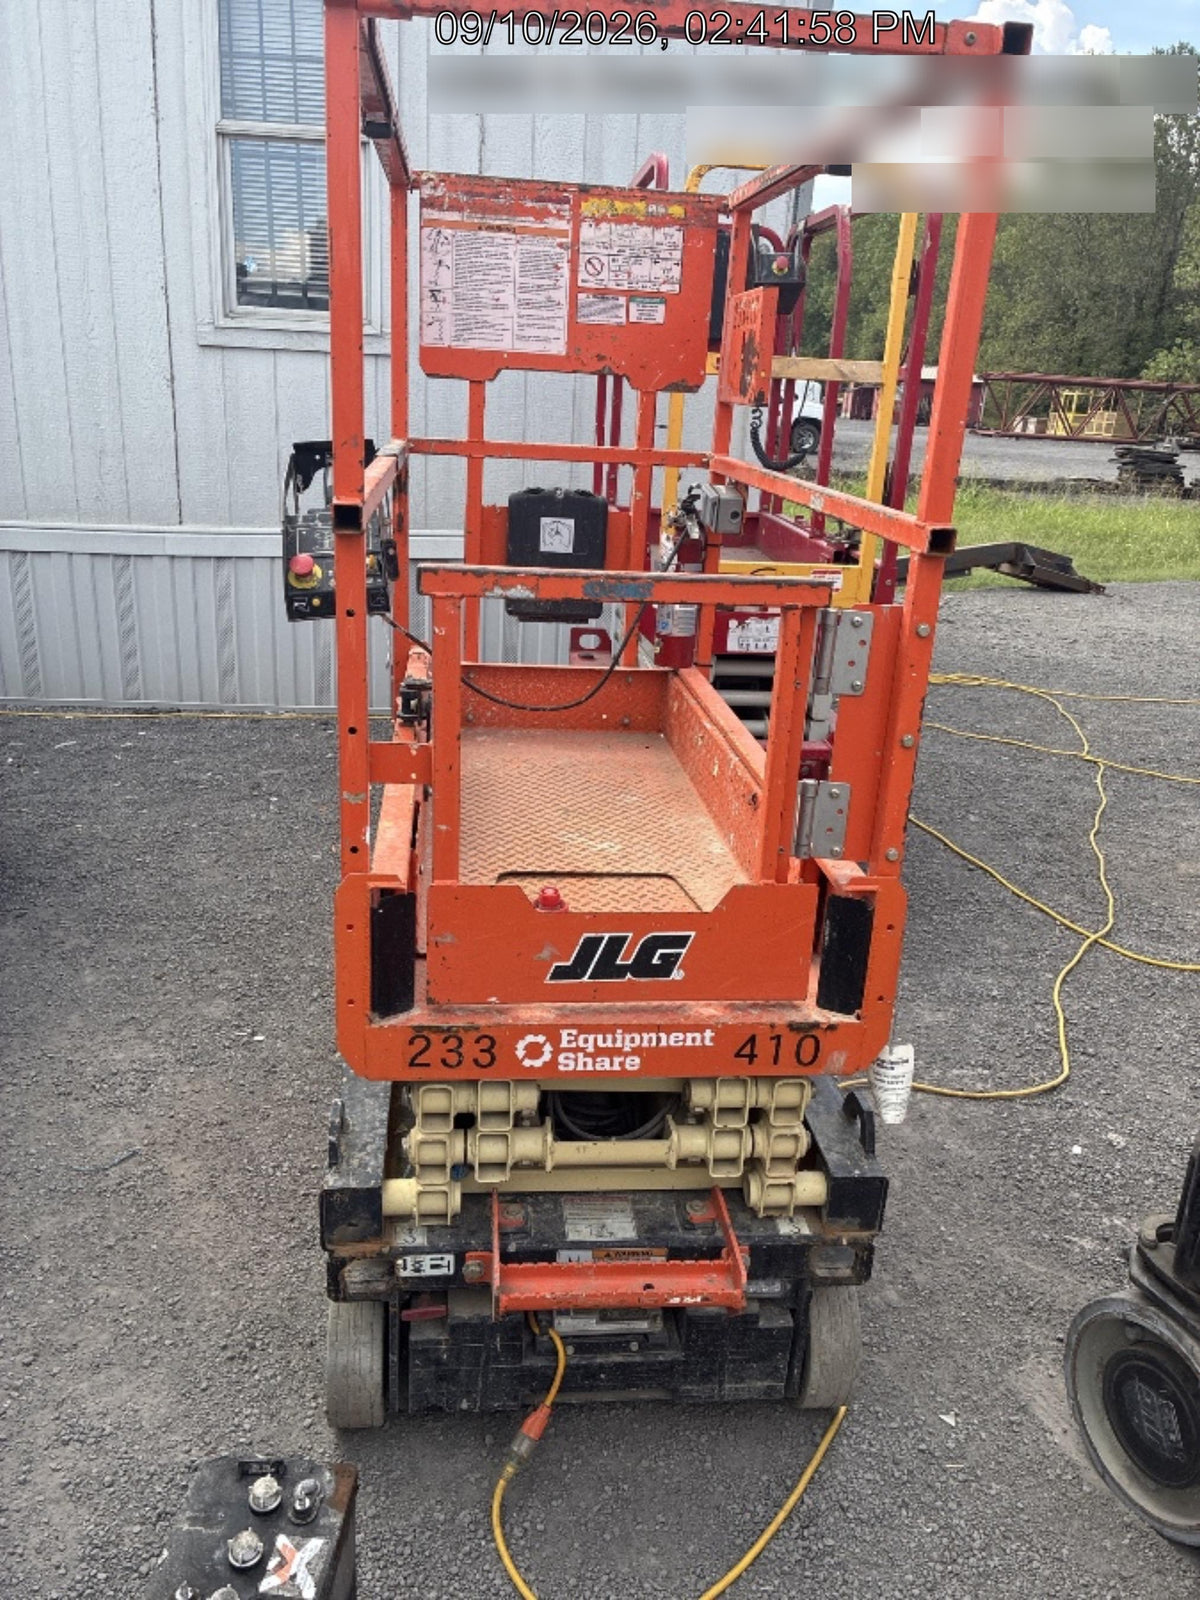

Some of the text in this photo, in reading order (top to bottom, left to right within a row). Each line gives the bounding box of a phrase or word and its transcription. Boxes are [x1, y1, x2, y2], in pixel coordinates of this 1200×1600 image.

[544, 931, 696, 983] JLG
[408, 1033, 497, 1069] 233
[559, 1028, 715, 1053] Equipment
[733, 1033, 821, 1067] 410
[557, 1051, 641, 1072] Share
